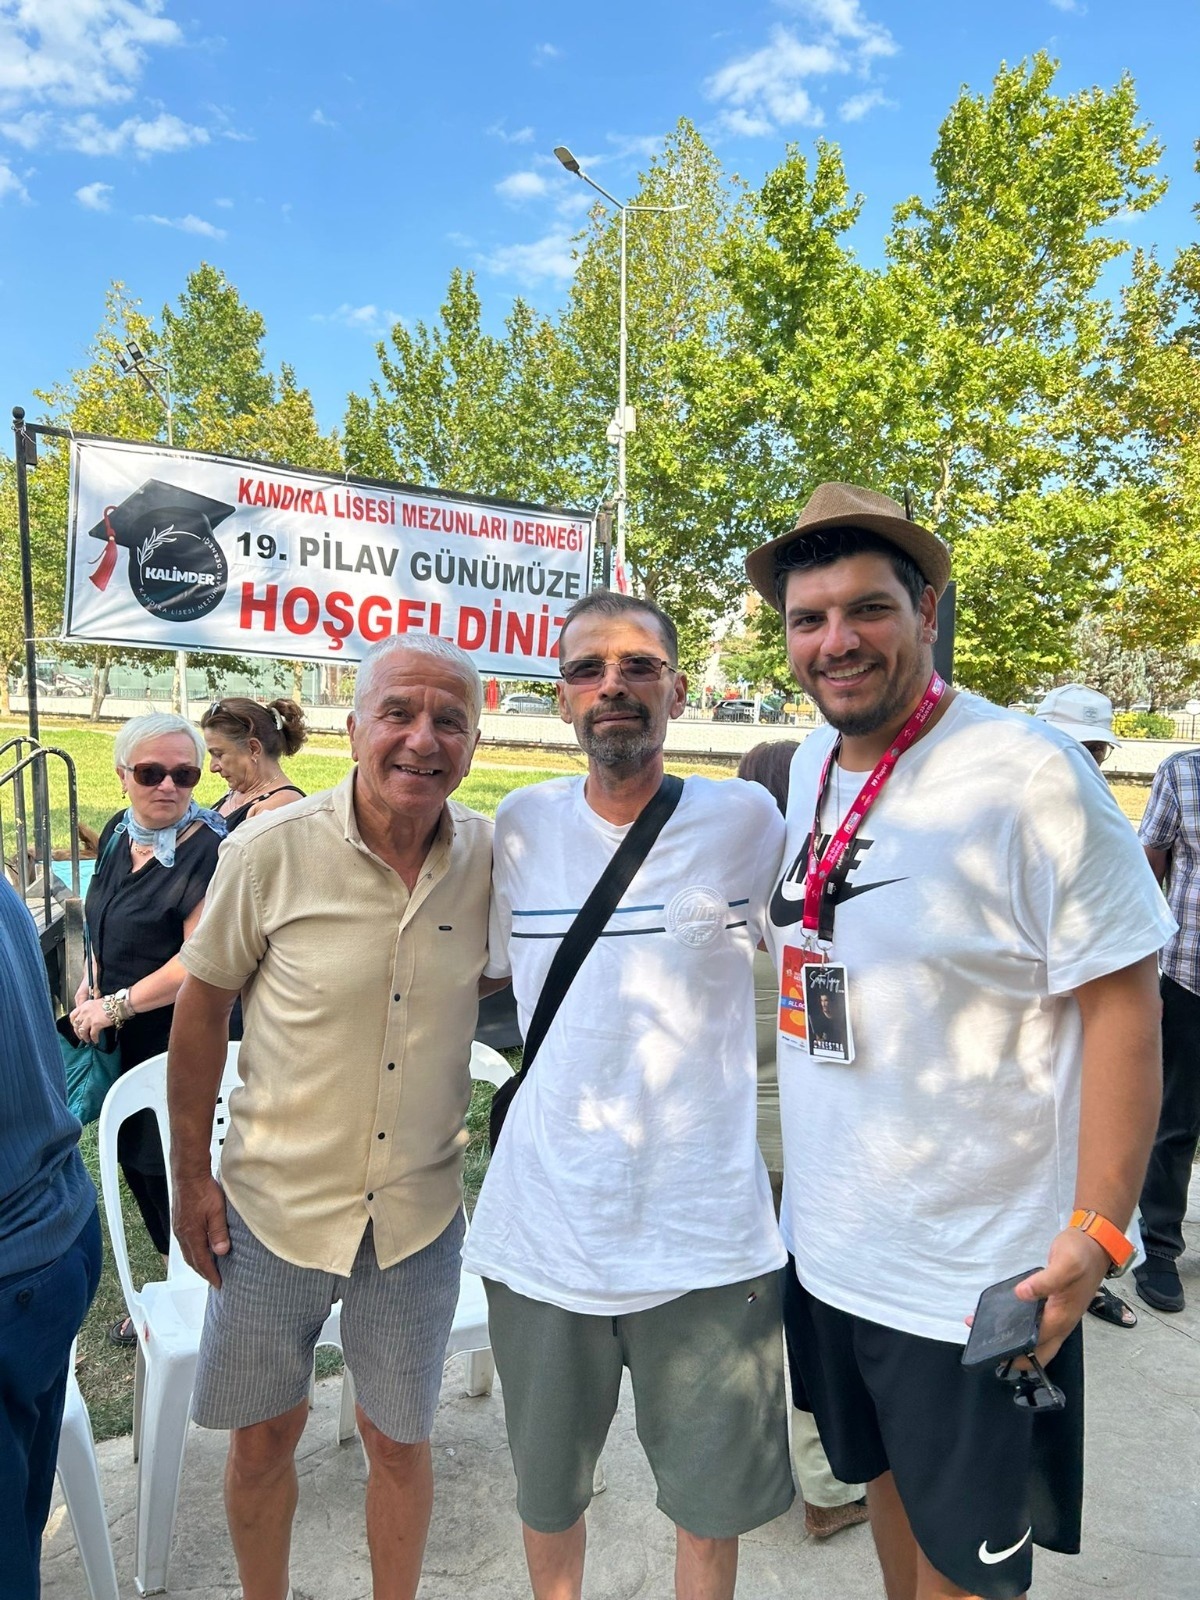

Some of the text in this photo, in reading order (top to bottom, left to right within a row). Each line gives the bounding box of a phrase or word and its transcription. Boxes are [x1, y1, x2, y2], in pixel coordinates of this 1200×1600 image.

[238, 477, 583, 552] KANDIRA LİSESİ MEZUNLARI DERNEĞİ
[145, 566, 216, 586] KALİMDER
[236, 531, 581, 600] 19. PİLAV GÜNÜMÜZE
